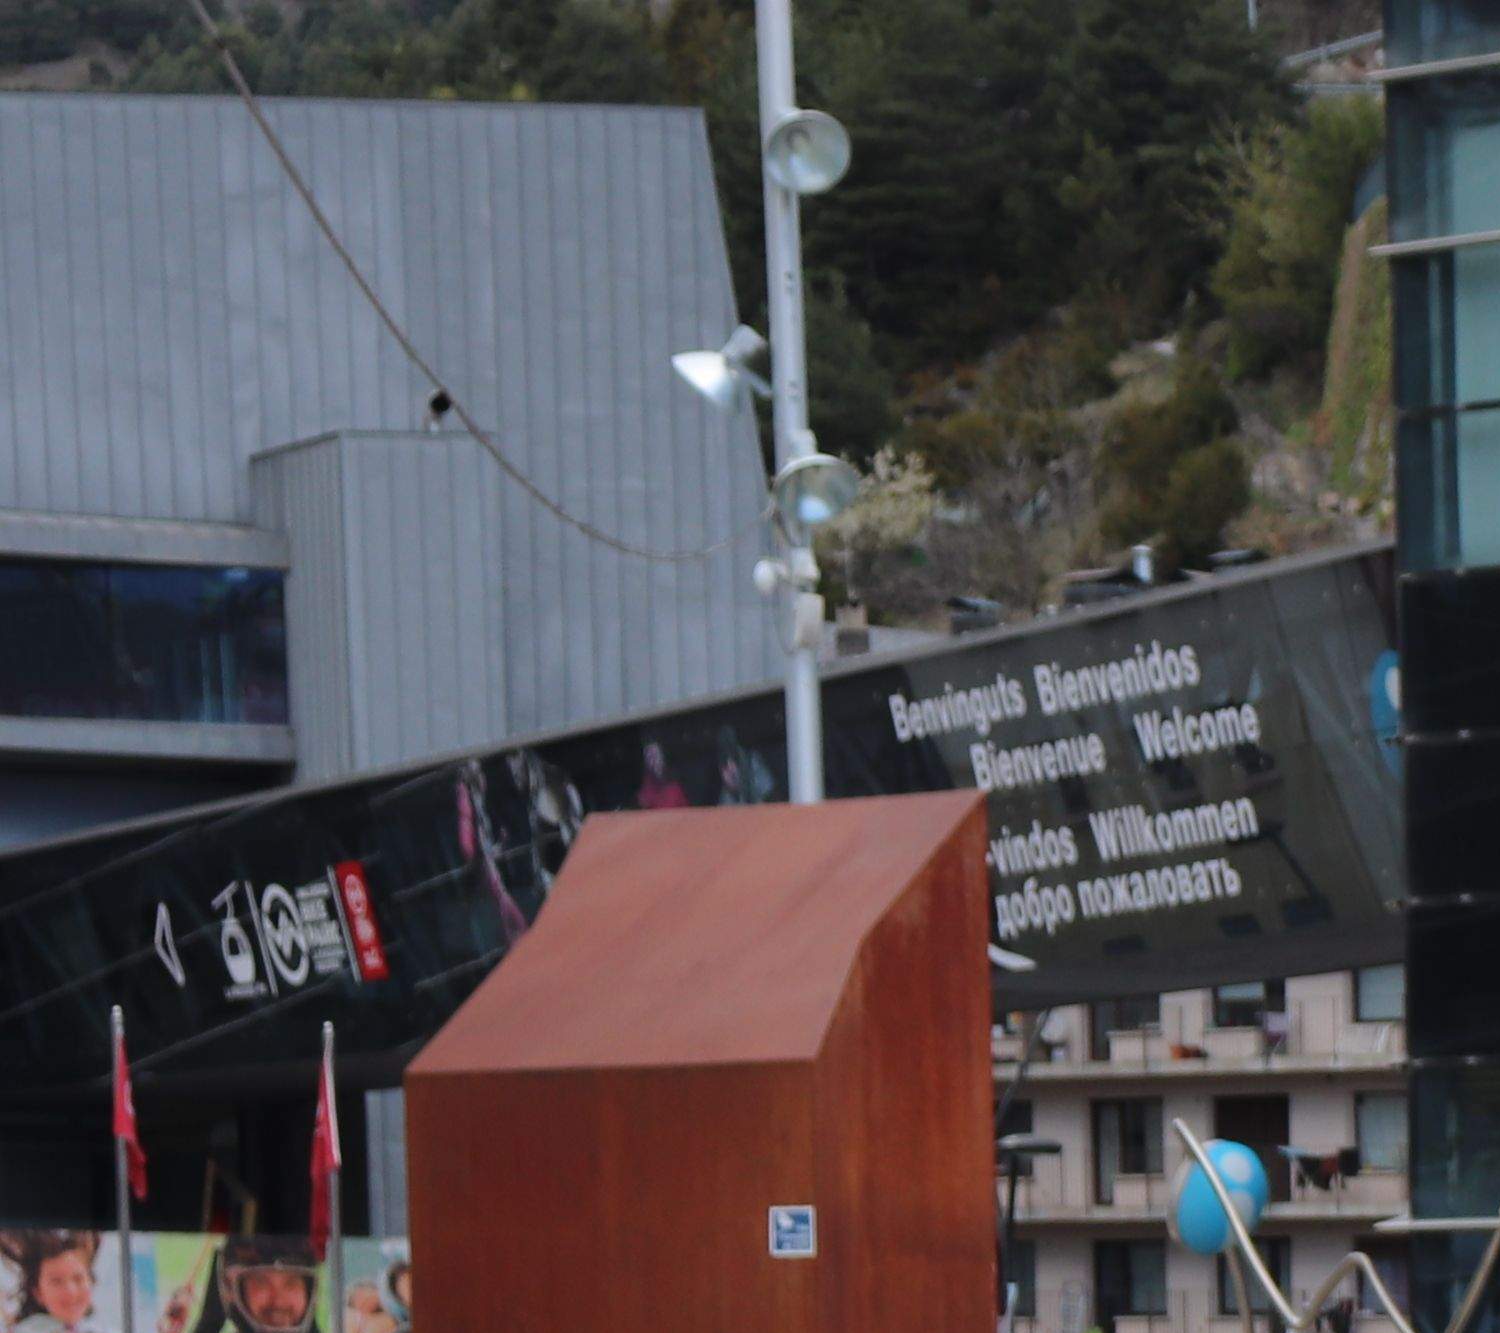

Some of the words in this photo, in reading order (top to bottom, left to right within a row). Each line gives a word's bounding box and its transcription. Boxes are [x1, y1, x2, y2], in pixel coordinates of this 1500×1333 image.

[889, 673, 1027, 742] Benvinguts
[1033, 640, 1200, 716] Bienvenidos
[970, 733, 1106, 792] Bienvenue
[1133, 703, 1261, 762] Welcome
[1089, 798, 1259, 863] Willkommen
[995, 876, 1076, 941] добро
[1077, 857, 1242, 918] пожаловать
